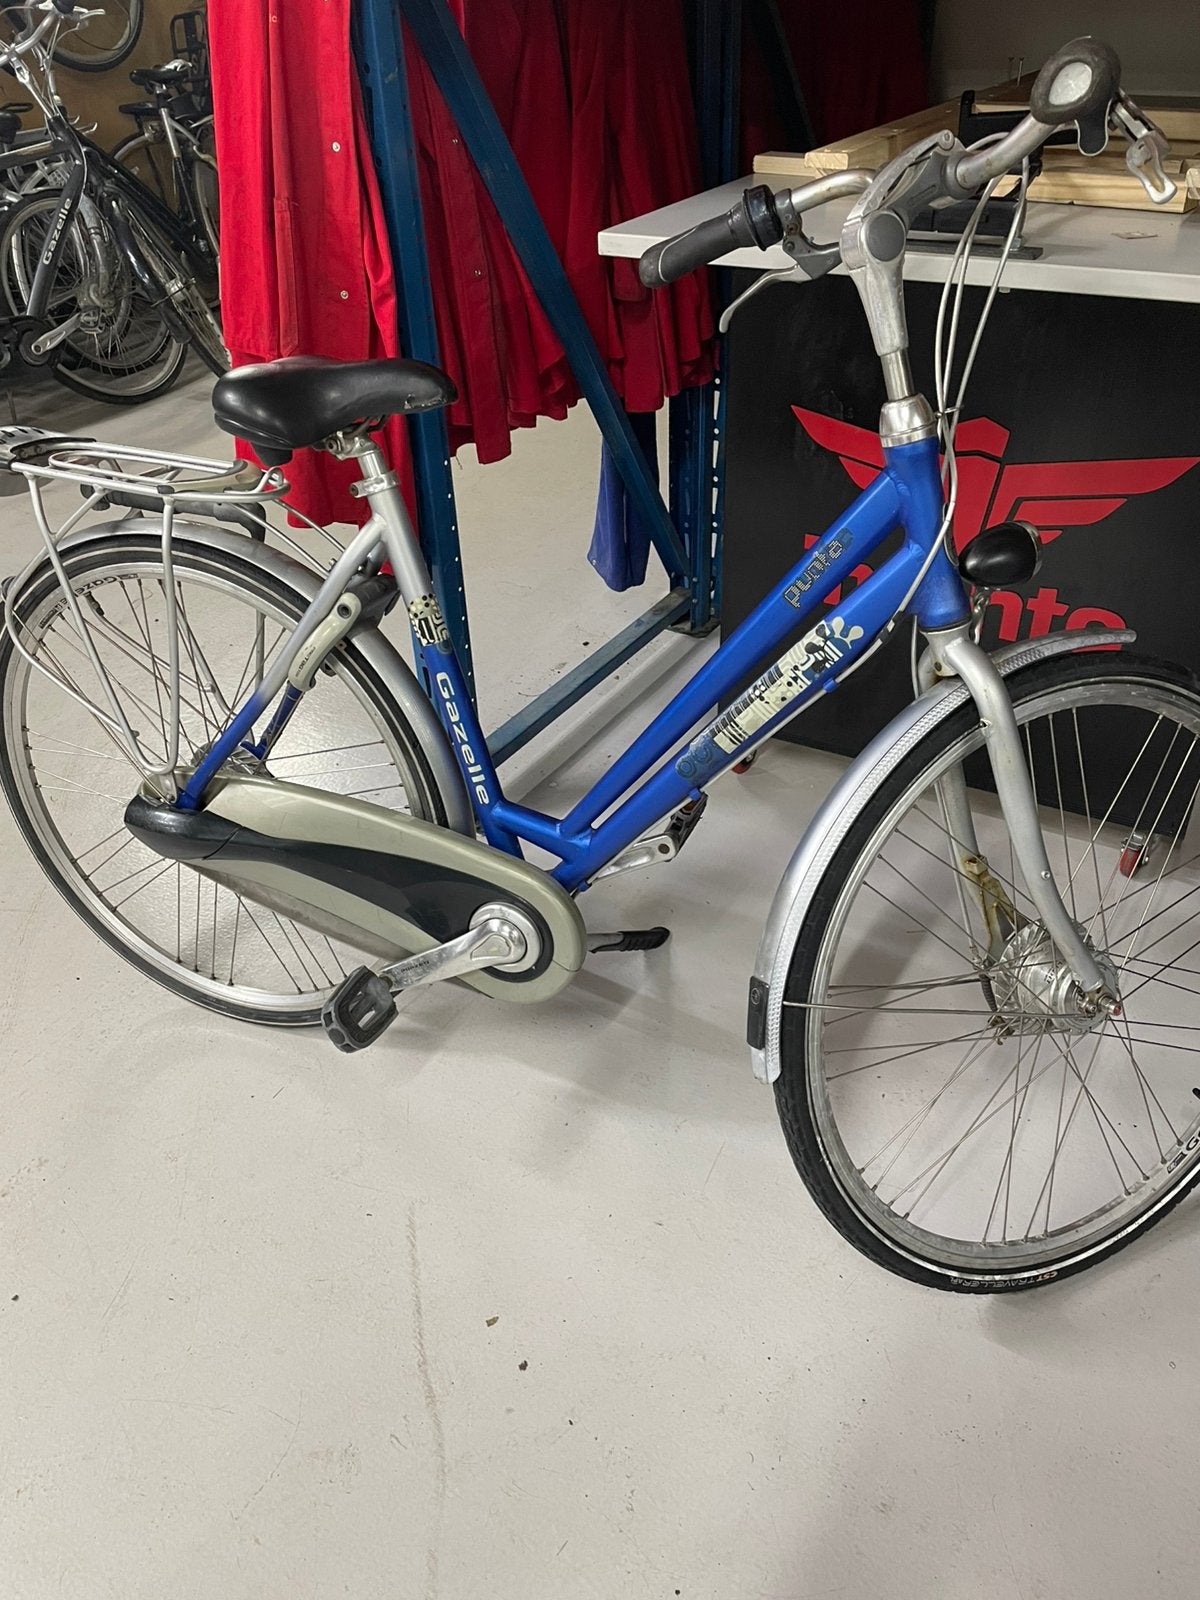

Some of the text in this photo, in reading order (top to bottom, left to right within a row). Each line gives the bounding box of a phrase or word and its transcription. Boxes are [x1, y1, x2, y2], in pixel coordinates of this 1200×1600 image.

[43, 198, 72, 265] Gazelle
[60, 576, 117, 605] Gazee
[436, 671, 489, 805] Gazelle
